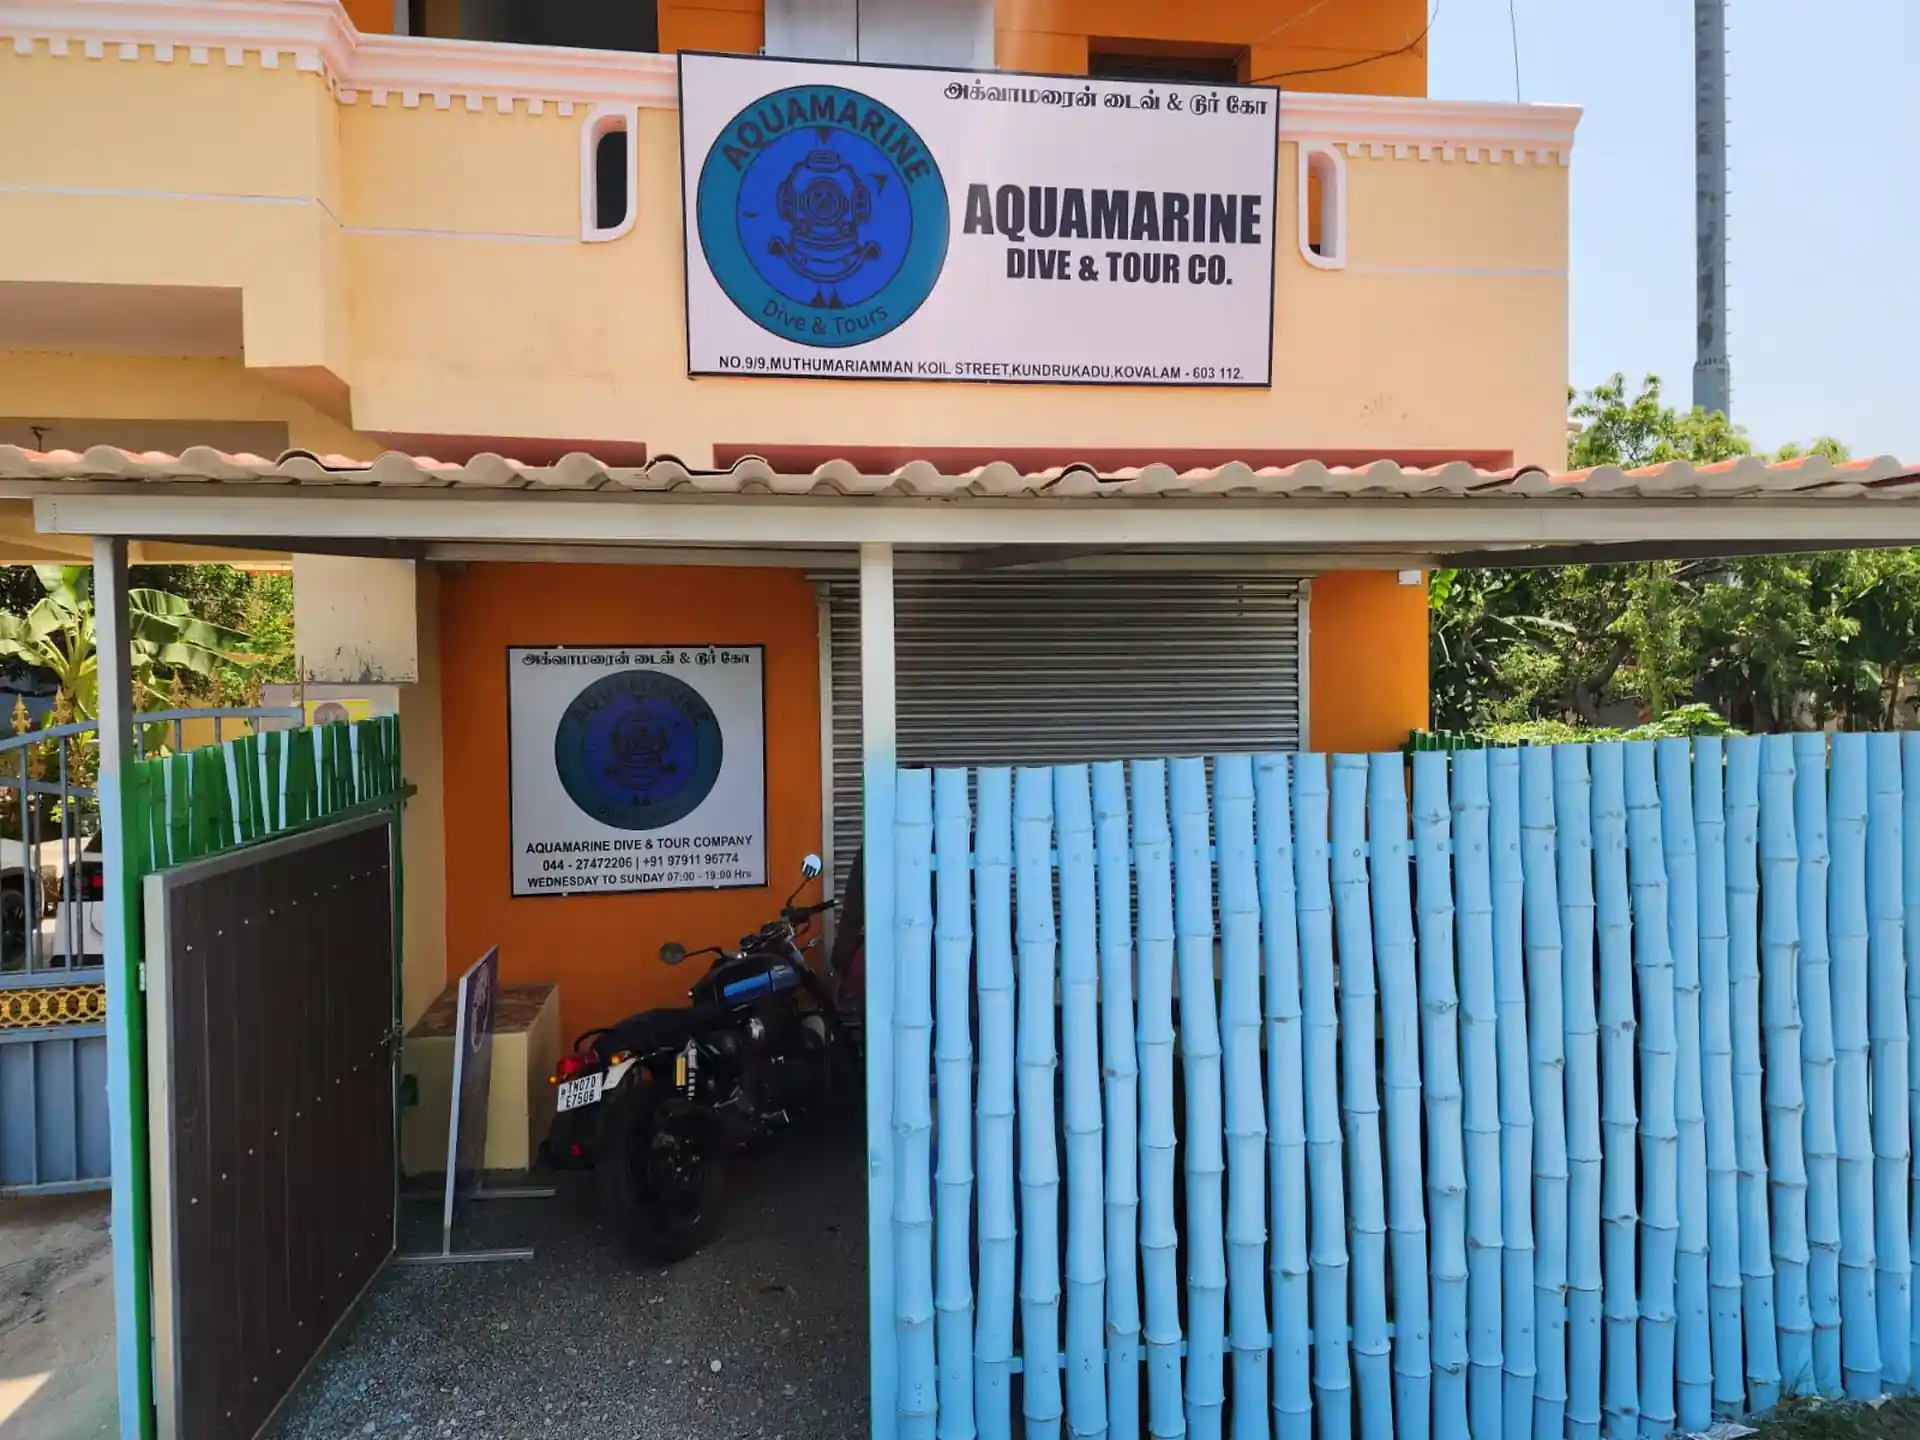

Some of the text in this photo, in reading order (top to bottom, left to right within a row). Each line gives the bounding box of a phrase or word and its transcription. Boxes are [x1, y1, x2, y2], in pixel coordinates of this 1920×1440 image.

[944, 78, 1267, 115] அக்வாமரைன் டைவ் & டூர் கோ
[721, 93, 931, 184] AQUAMARINE
[963, 184, 1261, 244] AQUAMARINE
[1007, 248, 1232, 285] DIVE & TOUR CO.
[762, 298, 888, 336] Dive & Tours
[918, 362, 951, 374] KOIL
[1193, 367, 1215, 379] 603
[635, 650, 674, 664] டைவ்
[680, 653, 690, 664] &
[721, 652, 749, 664] கோ
[526, 835, 752, 853] AQUAMARINE DIVE & TOUR COMPANY
[543, 860, 564, 871] 044
[576, 857, 632, 870] 27472206
[643, 856, 662, 867] +91
[668, 854, 699, 866] 97911
[705, 853, 738, 864] 96774
[528, 876, 599, 887] WEDNESDAY
[602, 875, 617, 884] TO
[620, 873, 664, 883] SUNDAY
[734, 870, 751, 878] Hrs
